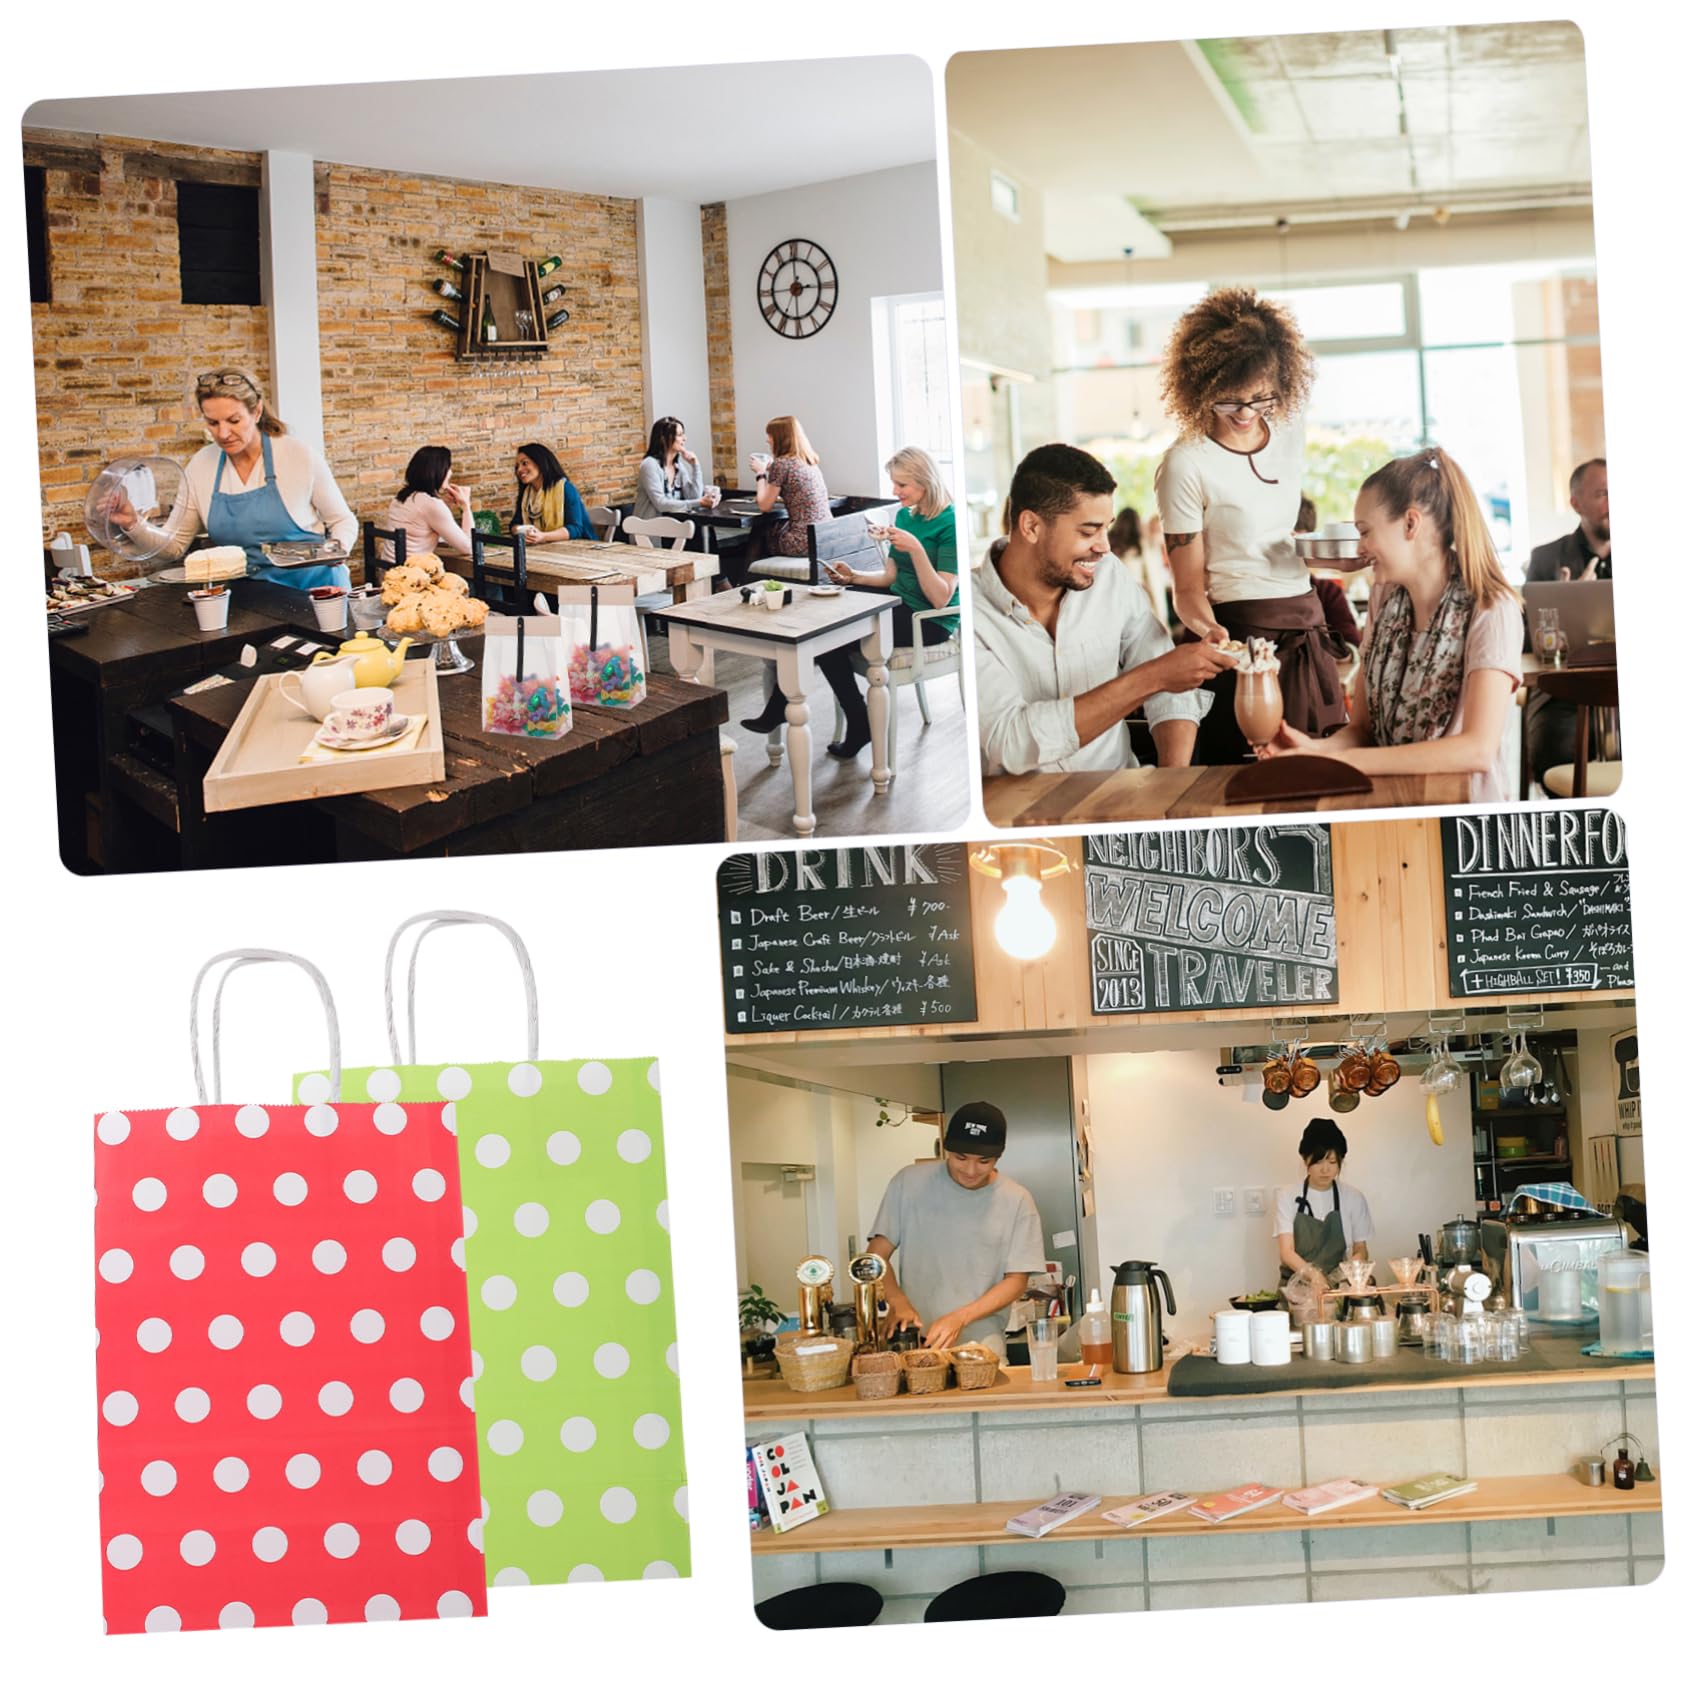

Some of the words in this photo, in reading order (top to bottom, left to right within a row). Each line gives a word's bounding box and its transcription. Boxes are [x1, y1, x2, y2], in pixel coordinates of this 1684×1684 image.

[1088, 824, 1281, 886] NEIGHBORS
[754, 845, 938, 892] DRINK
[1469, 884, 1503, 900] French
[1509, 881, 1537, 897] Fried
[1543, 881, 1554, 896] &
[750, 907, 790, 926] Draft
[1089, 873, 1335, 958] WELCOME
[747, 934, 799, 951] Japanese
[803, 931, 832, 947] Craft
[1096, 937, 1139, 972] SINCE
[1470, 948, 1511, 965] Japanese
[1544, 944, 1570, 961] Curry
[752, 960, 780, 977] Sake
[784, 960, 795, 973] &
[1145, 941, 1333, 1008] TRAVELER
[750, 984, 797, 1001] Japanese
[798, 980, 838, 996] Premium
[1099, 977, 1142, 1008] 2013
[793, 1003, 837, 1021] Cocktail
